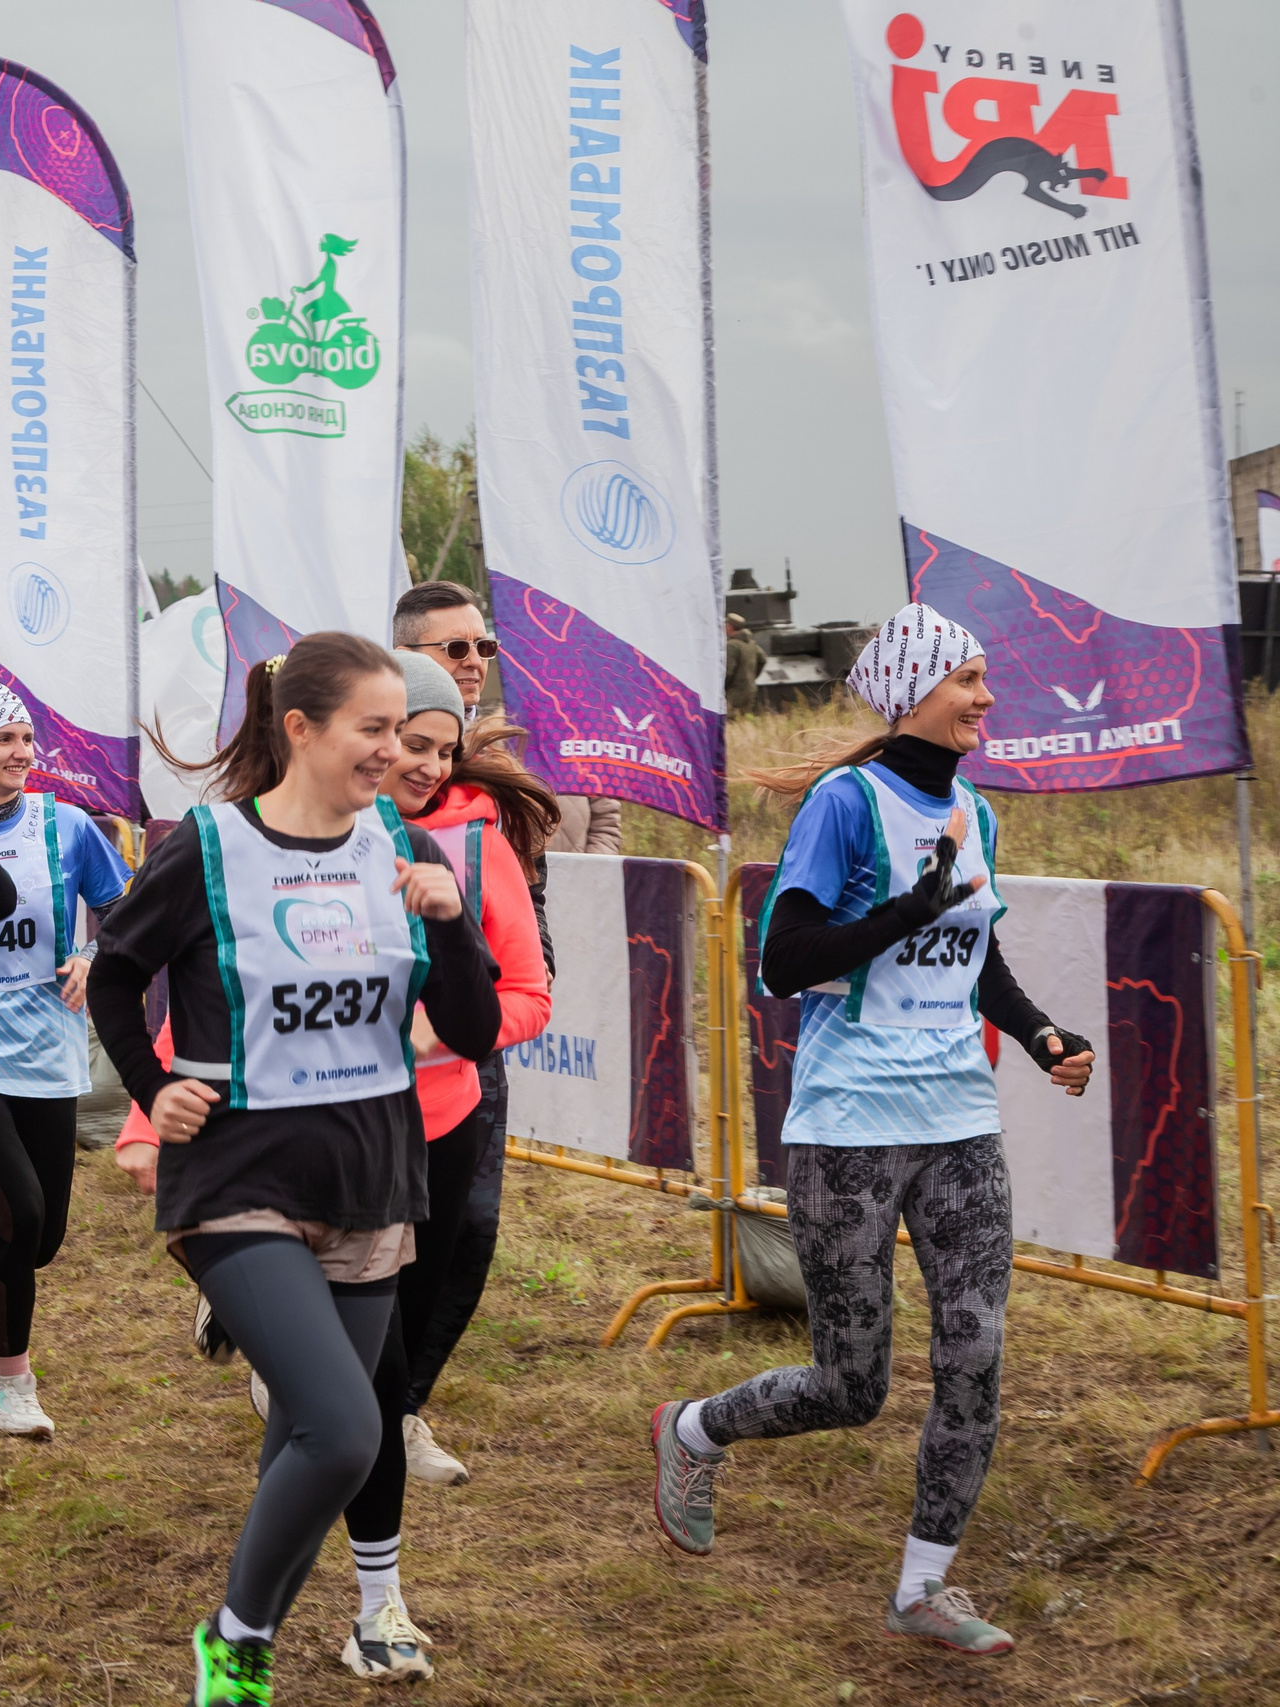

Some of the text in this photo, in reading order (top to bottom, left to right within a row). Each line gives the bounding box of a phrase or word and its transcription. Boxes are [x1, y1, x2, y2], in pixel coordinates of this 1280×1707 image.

[896, 637, 908, 680] TORERO
[928, 634, 941, 676] TORERO
[915, 837, 937, 847] ГОНК
[274, 871, 357, 886] ГОНКА ГЕРОЕВ
[301, 930, 339, 944] DENT
[896, 926, 980, 967] 5239
[272, 976, 390, 1036] 5237
[919, 1000, 965, 1010] ГАЗПРОМБАНК
[503, 1032, 598, 1081] РОМБАНК
[316, 1063, 379, 1082] ГАЗПРОМБАНК
